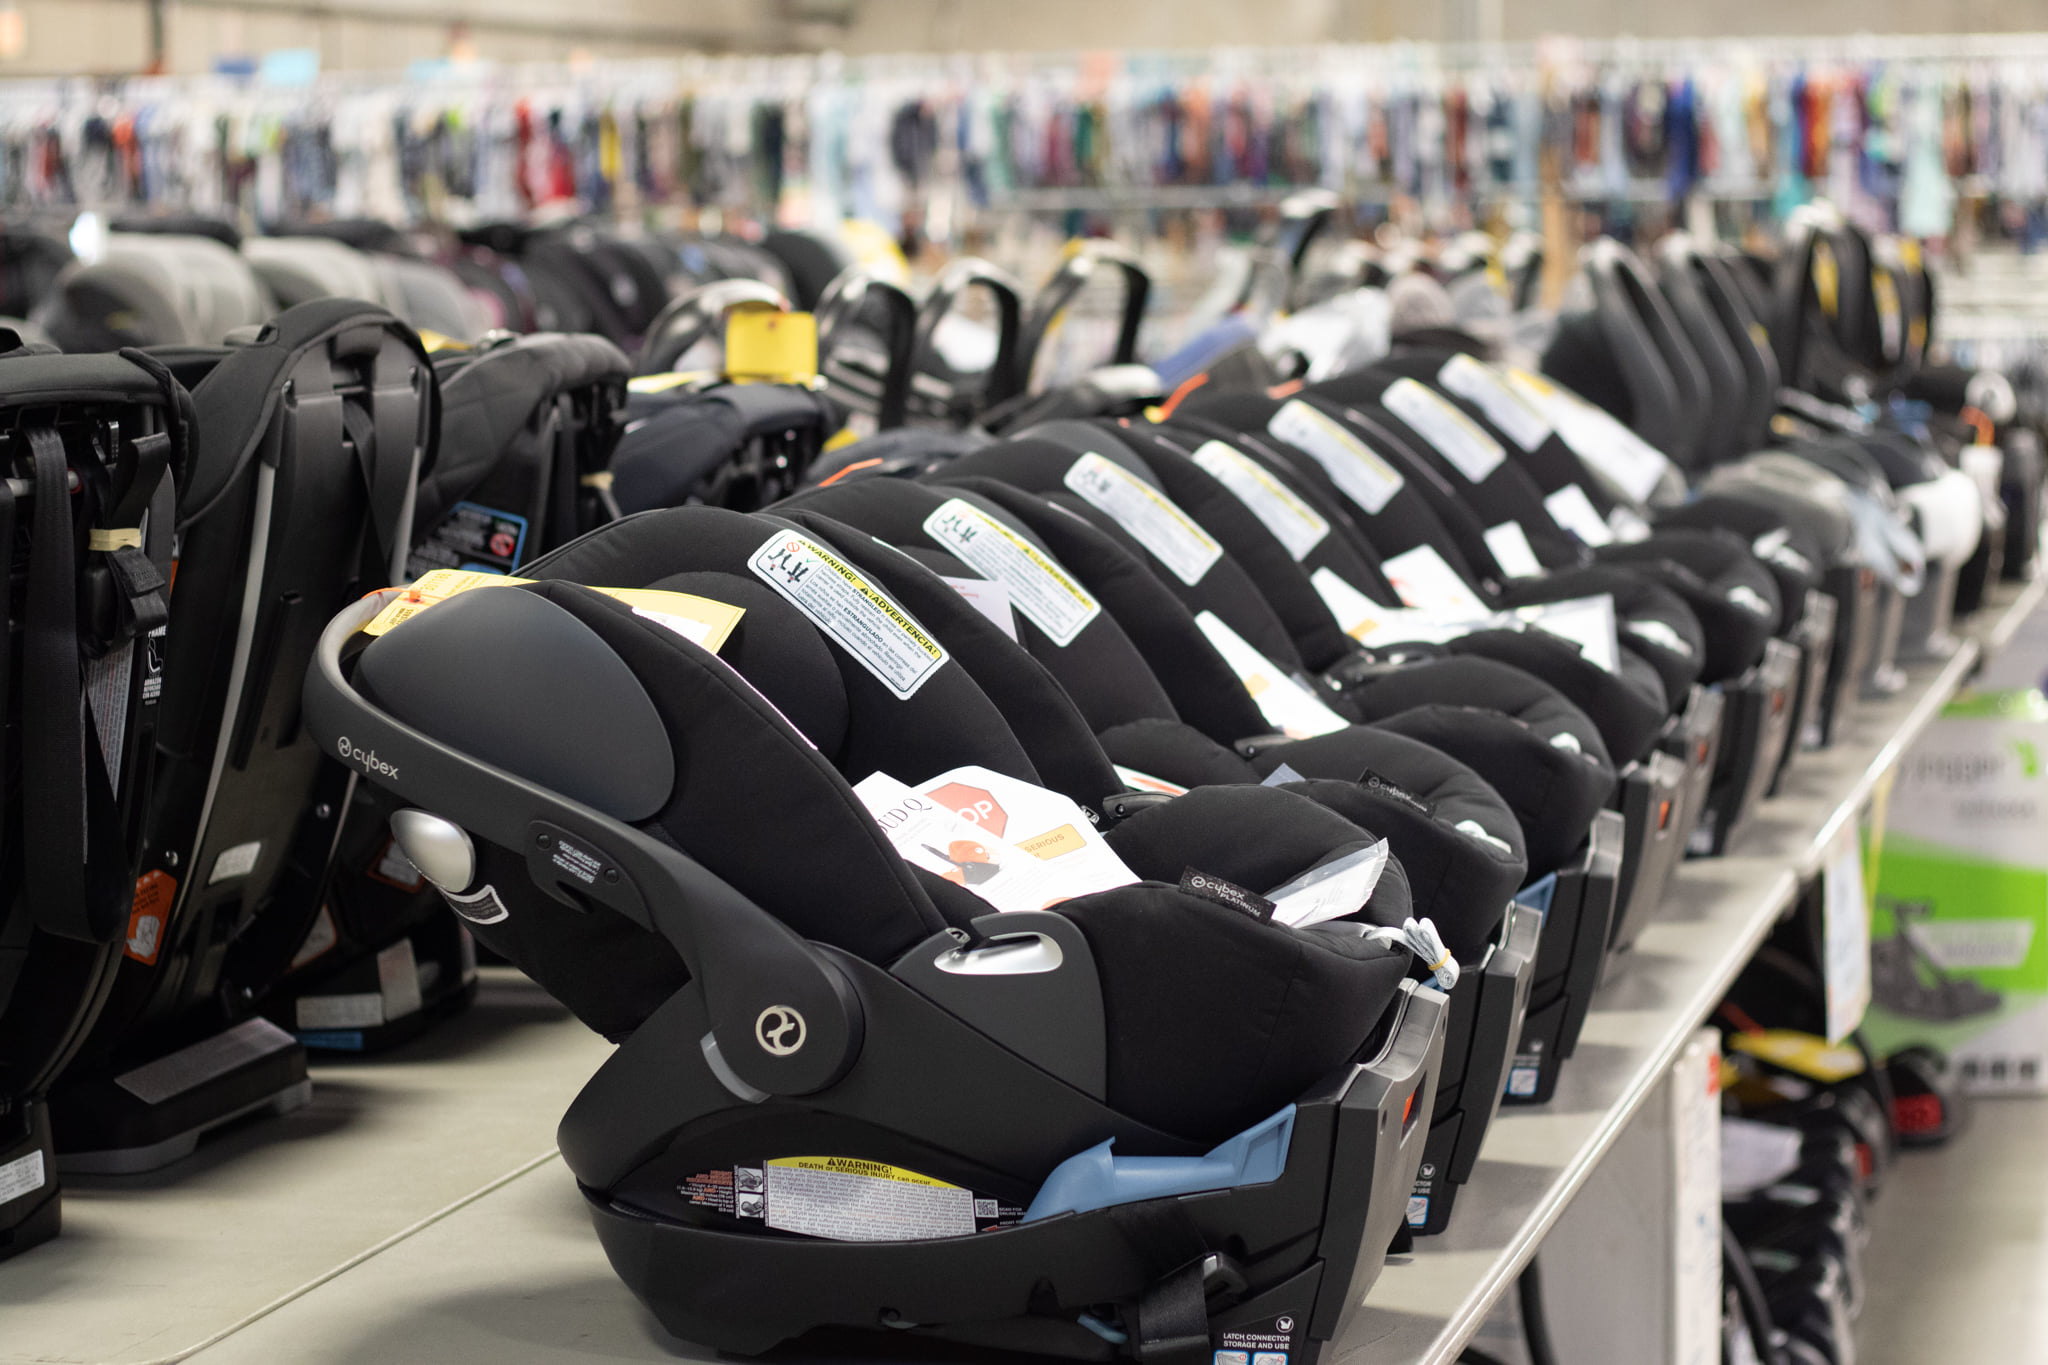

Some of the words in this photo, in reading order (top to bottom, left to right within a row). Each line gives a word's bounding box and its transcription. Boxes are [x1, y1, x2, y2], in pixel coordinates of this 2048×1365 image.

[807, 544, 856, 583] WARNING!
[851, 587, 882, 615] STRANGLED
[842, 606, 884, 643] ESTRANGULADO
[868, 592, 937, 655] ¡ADVERTENCIA!
[352, 747, 399, 780] cybex
[1024, 833, 1065, 853] SERIOUS
[1206, 879, 1245, 900] cybex
[1220, 892, 1261, 917] PLATINUM
[798, 1161, 824, 1171] DEATH
[835, 1167, 869, 1176] SERIOUS
[870, 1171, 895, 1180] INJURY
[836, 1158, 893, 1175] WARNING!
[1223, 1332, 1245, 1341] LATCH
[1246, 1333, 1291, 1342] CONNECTOR
[1223, 1340, 1257, 1349] STORAGE
[1257, 1341, 1274, 1349] AND
[1274, 1341, 1290, 1350] USE
